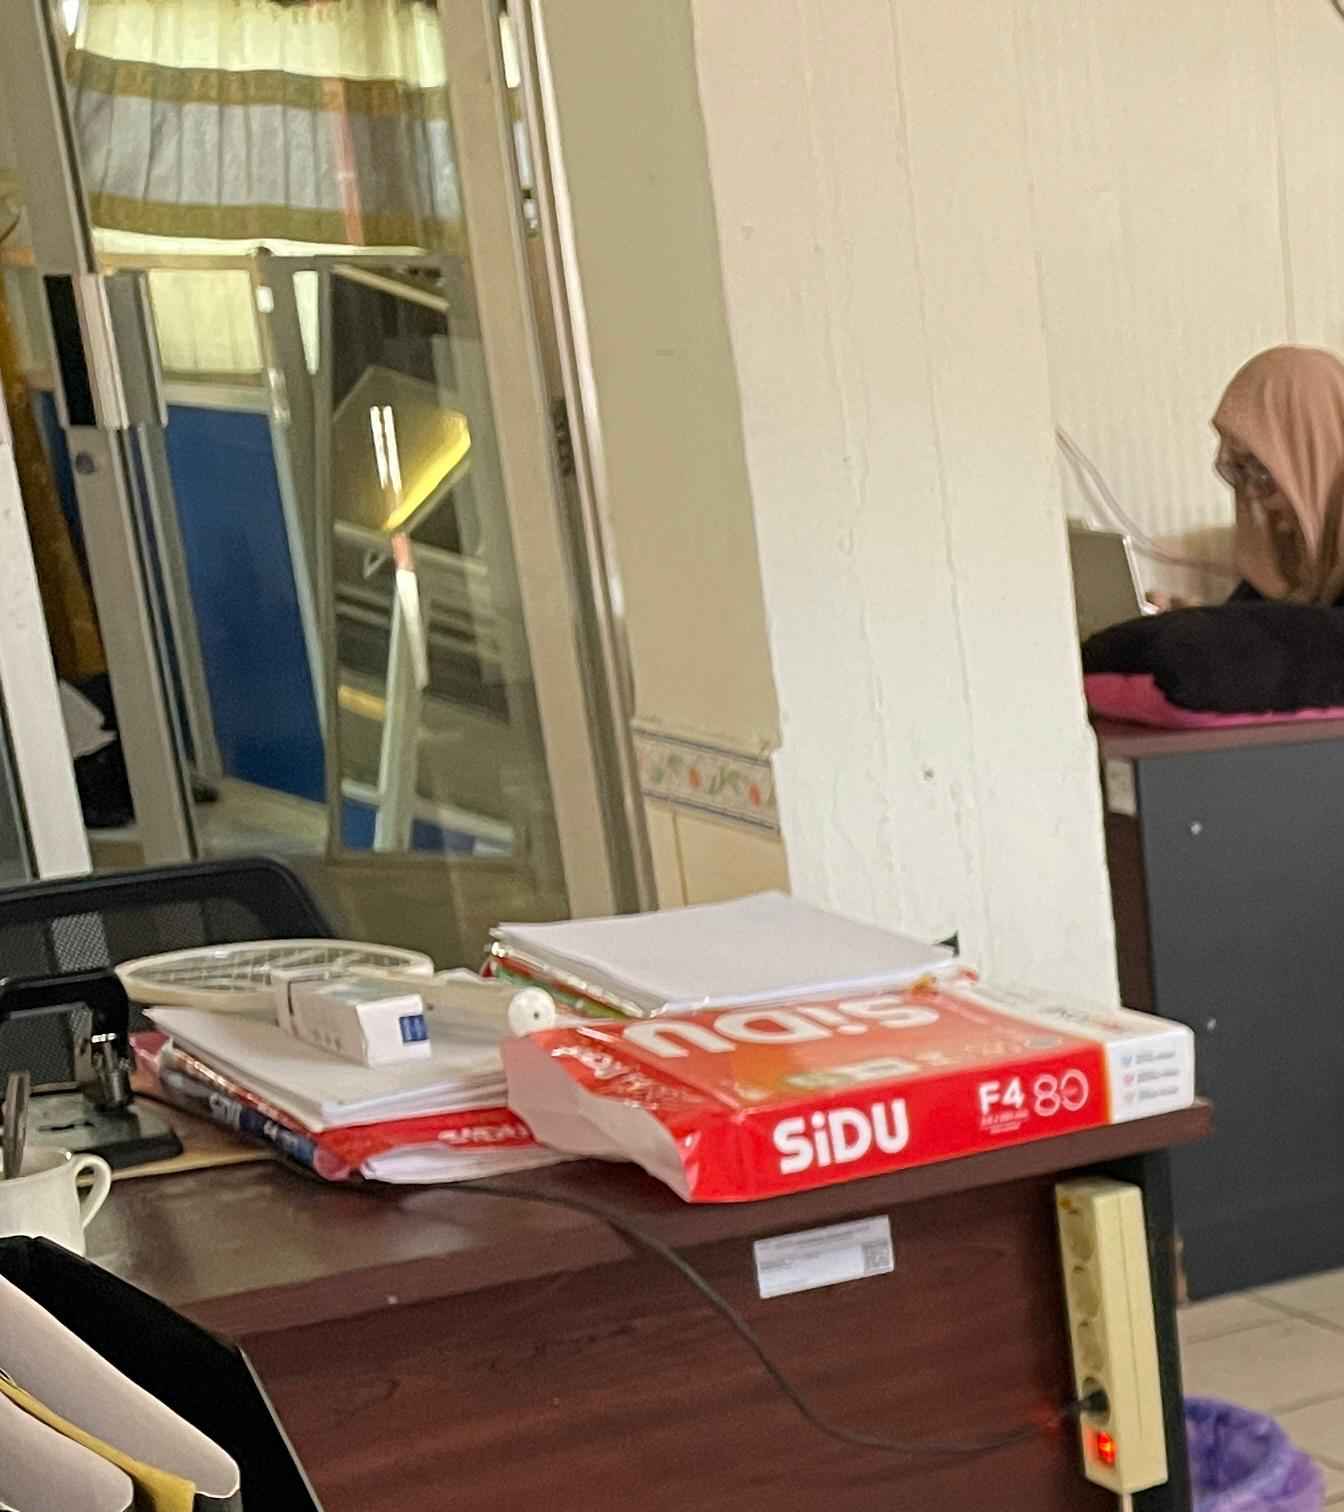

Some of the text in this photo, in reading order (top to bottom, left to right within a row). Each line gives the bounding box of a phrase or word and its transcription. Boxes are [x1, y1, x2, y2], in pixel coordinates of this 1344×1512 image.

[772, 1098, 911, 1174] SiDU
[977, 1077, 1026, 1117] F4
[1031, 1067, 1090, 1119] 80
